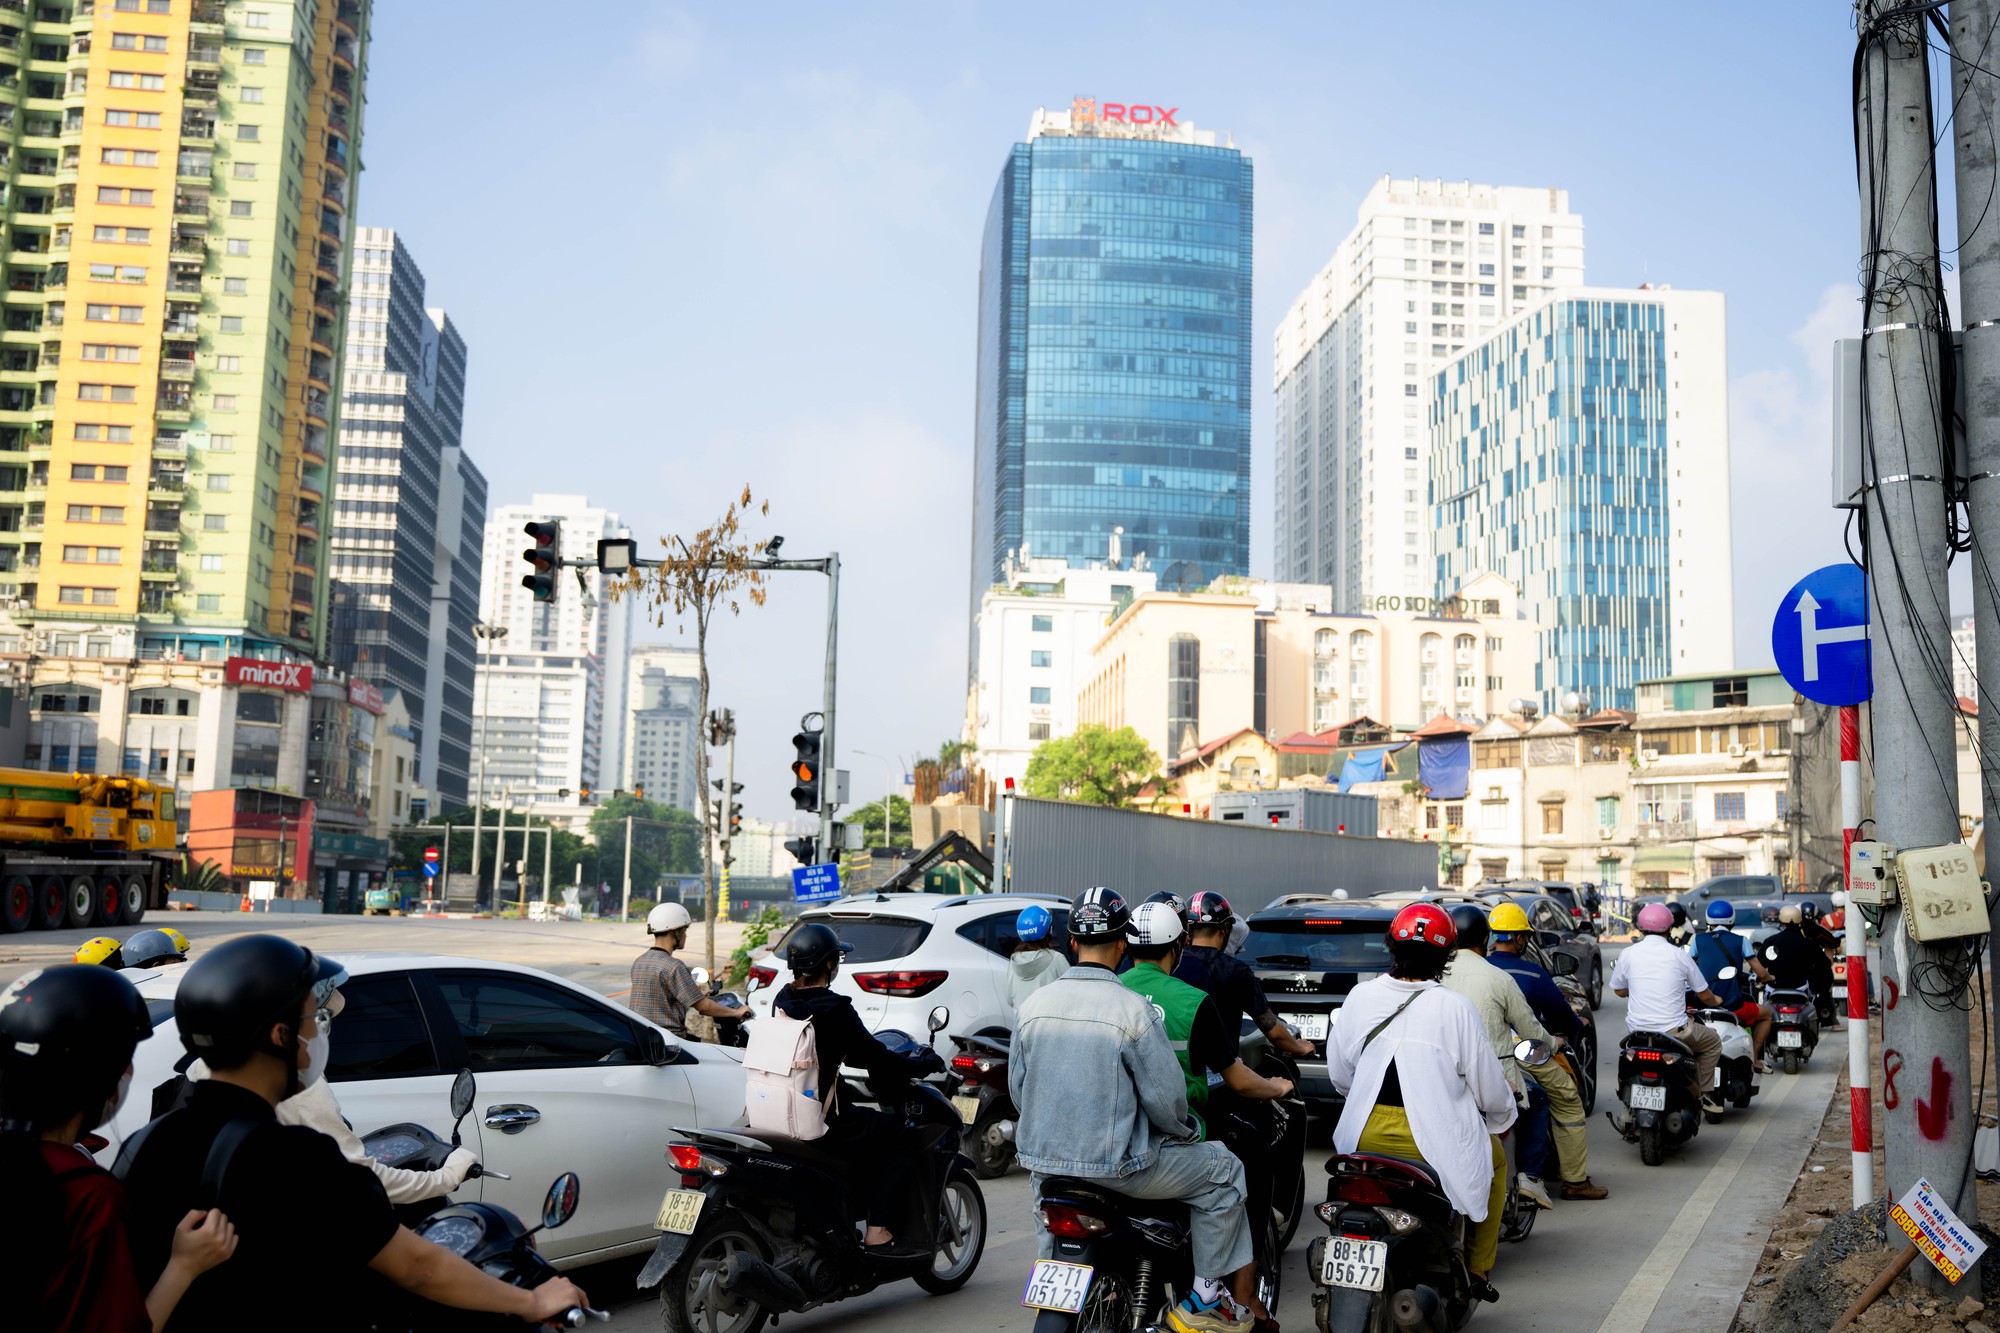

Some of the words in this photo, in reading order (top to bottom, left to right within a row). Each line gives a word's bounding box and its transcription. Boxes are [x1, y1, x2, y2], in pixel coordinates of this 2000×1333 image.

[1103, 103, 1179, 126] ROX
[239, 665, 301, 687] mindX
[1852, 882, 1876, 891] 19001515
[1292, 1014, 1314, 1025] 30G
[1636, 1087, 1661, 1098] 29-L5
[669, 1193, 698, 1212] 18-B1
[656, 1210, 696, 1231] 440.68
[1891, 1206, 1961, 1283] 0988.466.998
[1919, 1220, 1947, 1251] CAMERA
[1333, 1241, 1375, 1264] 88-K1
[1951, 1243, 1966, 1256] FPT
[1039, 1264, 1082, 1287] 22-T1
[1325, 1261, 1380, 1287] 056.77
[1028, 1284, 1081, 1310] 051.73
